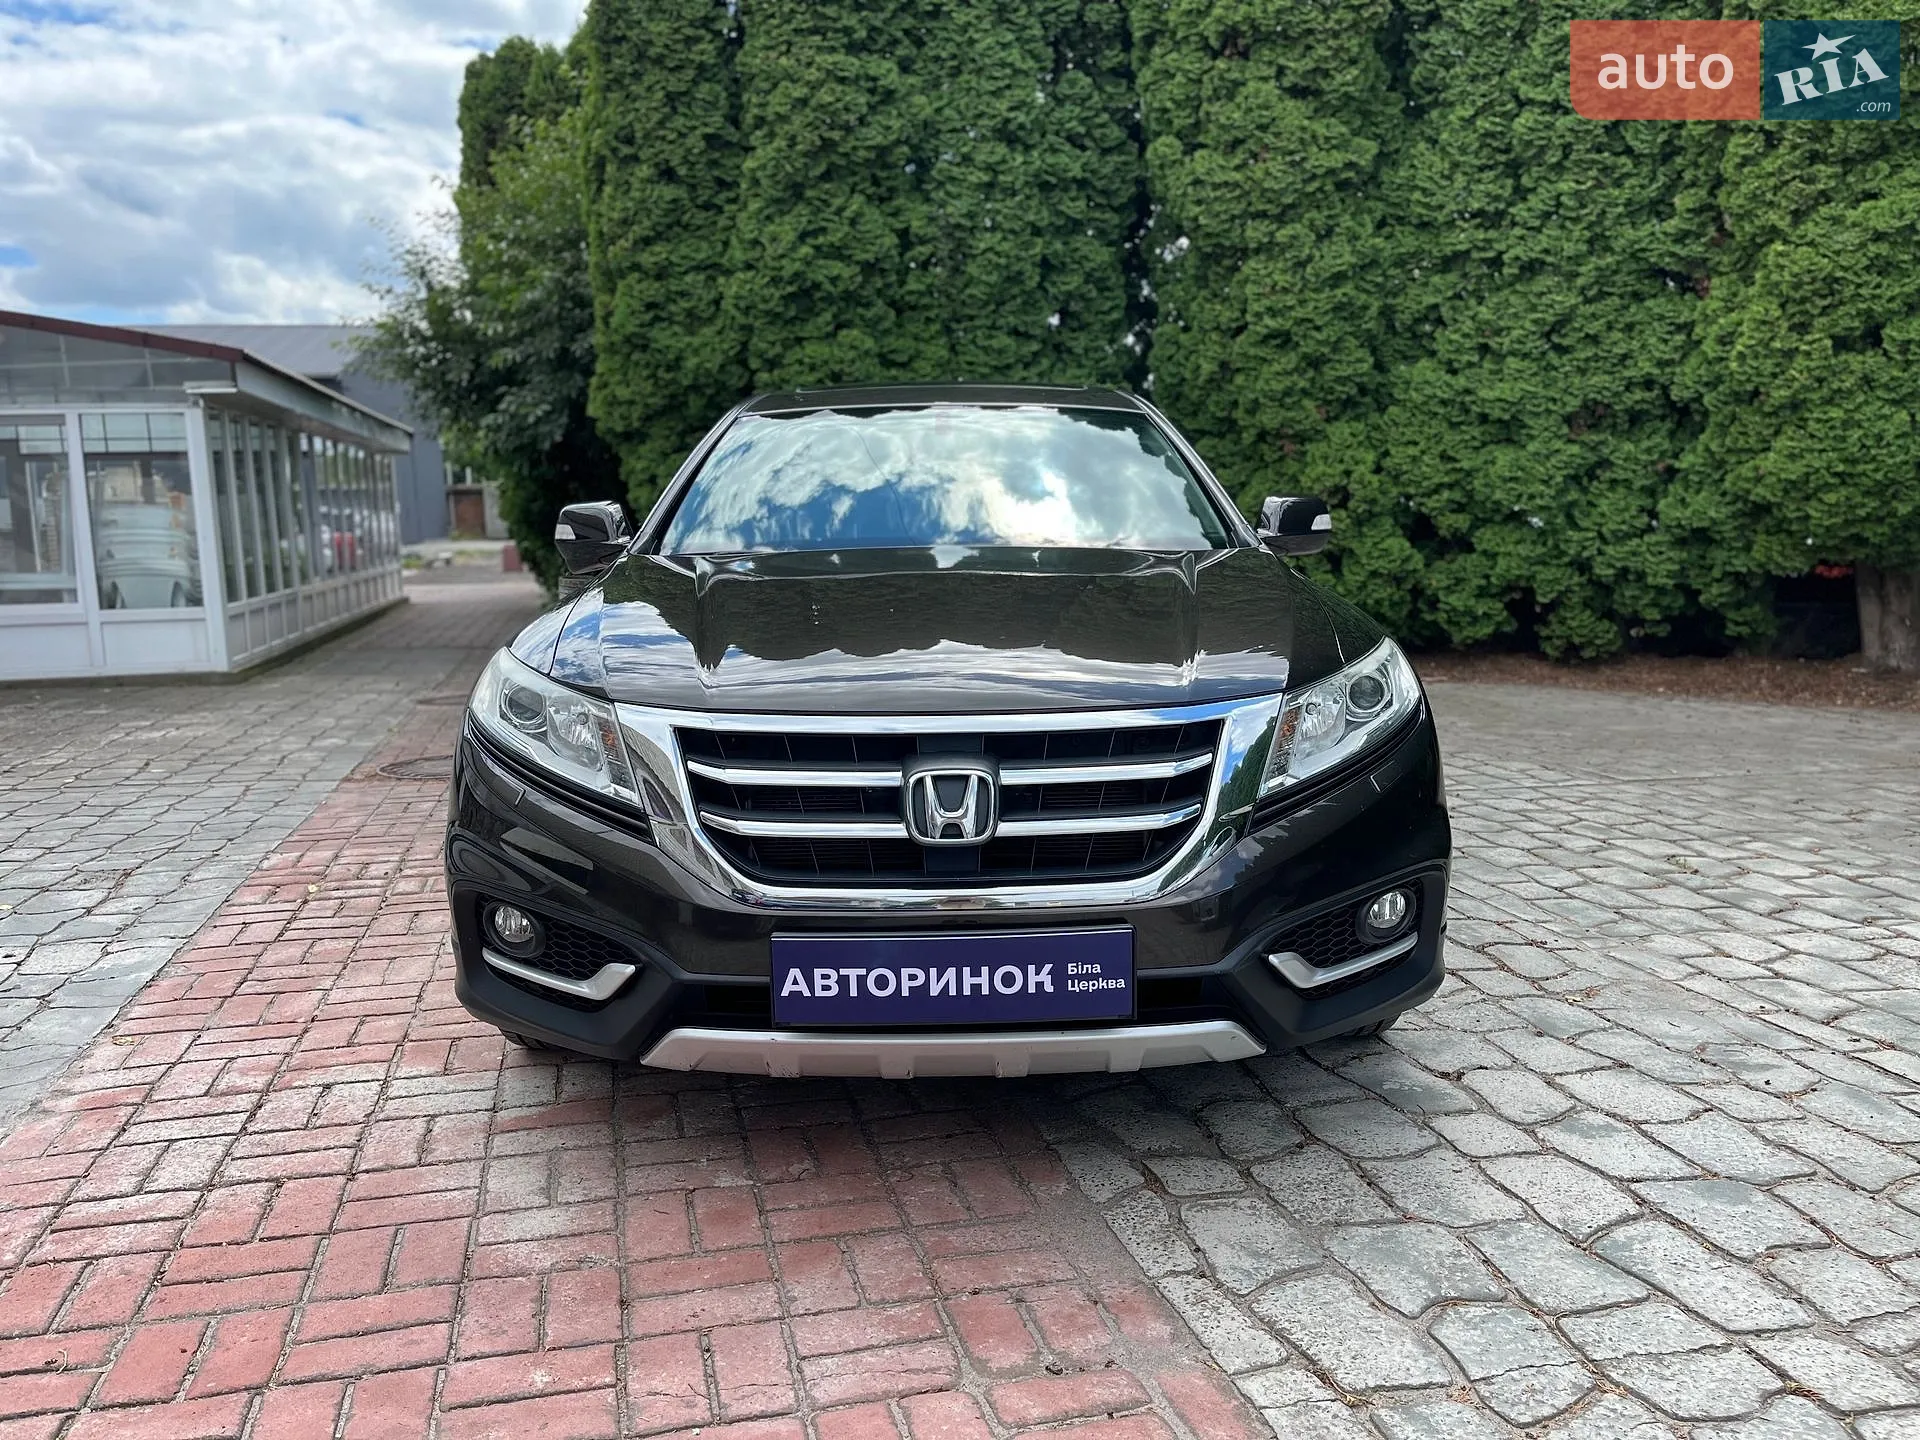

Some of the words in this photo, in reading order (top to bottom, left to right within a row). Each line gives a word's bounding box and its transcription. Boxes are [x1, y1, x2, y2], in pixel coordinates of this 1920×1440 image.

[1067, 962, 1101, 975] Біла
[780, 963, 1054, 998] АВТОРИНОК
[1067, 977, 1125, 993] Церква
